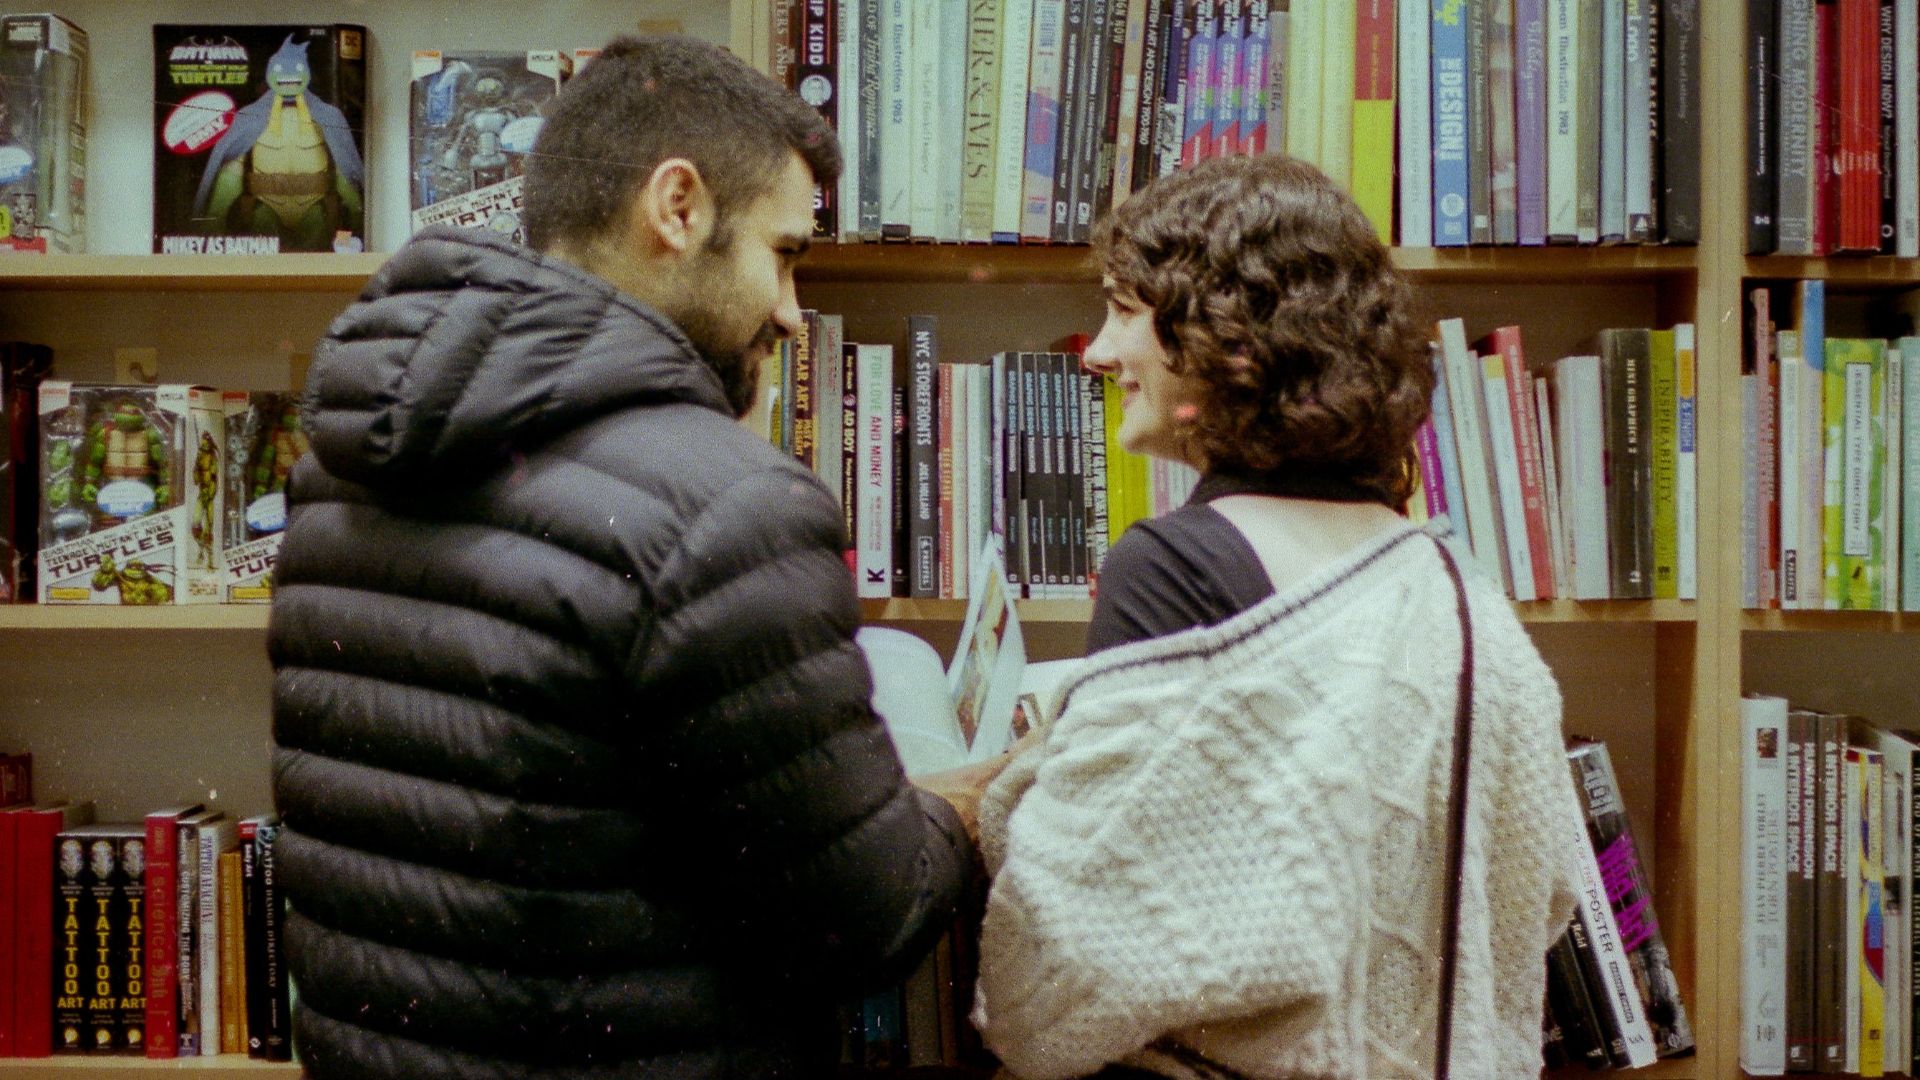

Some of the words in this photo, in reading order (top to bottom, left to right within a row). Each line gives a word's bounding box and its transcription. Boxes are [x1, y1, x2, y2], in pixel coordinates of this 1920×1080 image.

[1114, 20, 1125, 43] NOW
[1147, 29, 1159, 45] ART
[1881, 6, 1892, 35] WHY
[169, 46, 248, 60] BATMAN
[809, 24, 824, 65] KIDD
[893, 24, 904, 92] Illustration
[1145, 48, 1157, 69] AND
[1881, 37, 1892, 80] DESIGN
[170, 72, 249, 84] TURTLES
[1142, 70, 1154, 104] DESIGN
[1557, 36, 1570, 104] Illustration
[892, 99, 904, 124] 1982
[1881, 84, 1892, 118] NOW?
[1557, 111, 1569, 135] 1982
[1791, 68, 1807, 177] MODERNITY
[967, 113, 991, 178] IVES
[163, 236, 204, 254] MIKEY
[207, 237, 224, 254] AS
[225, 237, 279, 254] BATMAN
[796, 321, 810, 381] POPULAR
[915, 331, 931, 357] NYC
[870, 355, 882, 381] FOR
[1626, 358, 1636, 384] MINI
[796, 385, 810, 411] ART
[870, 383, 882, 411] LOVE
[915, 362, 931, 446] STOREFRONTS
[1854, 372, 1862, 430] ESSENTIAL
[844, 409, 854, 426] AD
[870, 415, 882, 441] AND
[1627, 387, 1637, 443] GRAPHICS
[844, 428, 854, 453] BOY
[1659, 379, 1671, 504] INSPIRABILITY
[1854, 437, 1862, 463] TYPE
[870, 445, 882, 488] MONEY
[918, 462, 930, 482] JOEL
[918, 483, 930, 520] HOLLAND
[46, 547, 88, 566] TEENAGE
[49, 530, 174, 579] TURTLES
[921, 550, 930, 586] PRESTEL
[867, 568, 885, 583] K
[1804, 742, 1815, 795] HUMAN
[1787, 755, 1800, 822] INTERIOR
[1825, 754, 1837, 822] INTERIOR
[1787, 825, 1800, 872] SPACE
[1804, 799, 1815, 880] DIMENSION
[1825, 825, 1837, 872] SPACE
[263, 843, 273, 887] TATTOO
[180, 871, 191, 933] CUSTOMIZING
[1586, 888, 1614, 953] POSTER
[65, 898, 79, 995] TATTOO
[96, 899, 110, 996] TATTOO
[127, 898, 142, 996] TATTOO
[181, 936, 191, 953] THE
[182, 954, 191, 980] BODY
[57, 997, 84, 1009] ART
[89, 998, 116, 1010] ART
[121, 998, 147, 1009] ART
